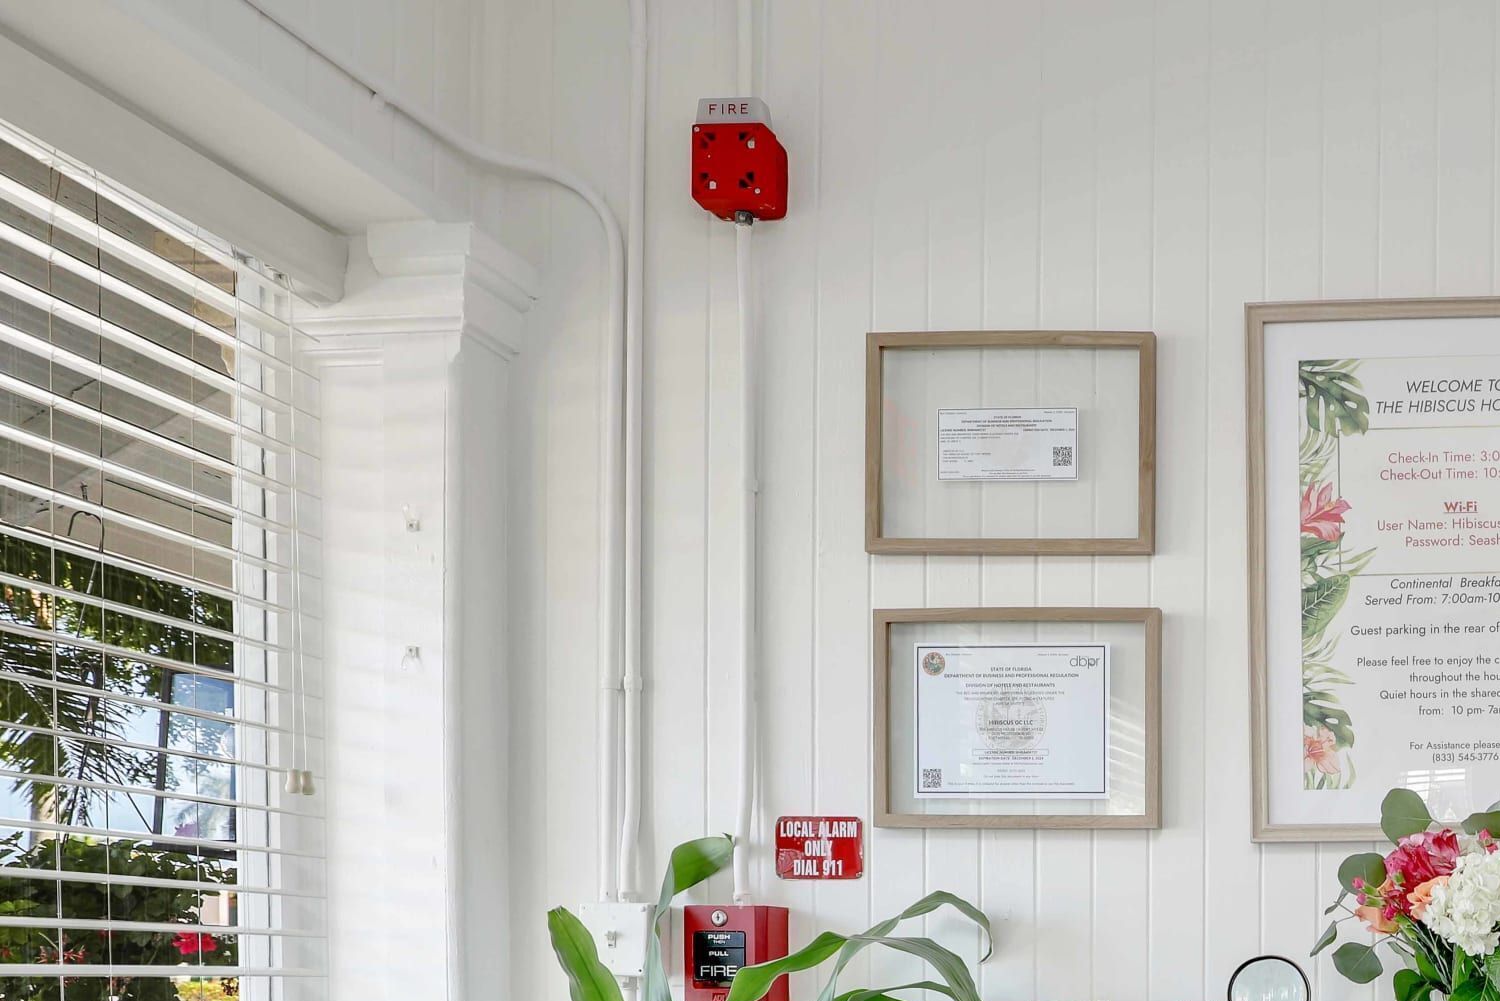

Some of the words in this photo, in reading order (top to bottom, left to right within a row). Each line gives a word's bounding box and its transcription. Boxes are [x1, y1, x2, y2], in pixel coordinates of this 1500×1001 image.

[708, 103, 749, 115] FIRE
[1406, 379, 1483, 394] WELCOME
[1376, 400, 1404, 414] THE
[1408, 398, 1475, 414] HIBISCUS
[1388, 450, 1439, 464] Check-In
[1443, 451, 1475, 463] Time:
[1380, 467, 1442, 481] Check-Out
[1446, 467, 1478, 480] Time:
[1444, 501, 1478, 514] Wi-Fi
[1378, 519, 1404, 531] User
[1408, 519, 1447, 531] Name:
[1406, 533, 1464, 547] Password:
[1390, 576, 1453, 590] Continental
[1365, 593, 1403, 606] Served
[1406, 594, 1437, 605] From:
[1350, 625, 1382, 636] Guest
[1386, 623, 1426, 638] parking
[1430, 624, 1440, 634] in
[1444, 622, 1461, 634] the
[1464, 625, 1485, 634] rear
[1489, 621, 1500, 633] of
[1357, 656, 1388, 667] Please
[1391, 655, 1409, 666] feel
[1412, 655, 1431, 666] free
[1434, 657, 1444, 665] to
[1446, 656, 1473, 668] enjoy
[1476, 654, 1491, 665] the
[1410, 671, 1462, 685] throughout
[1465, 671, 1481, 681] the
[1380, 690, 1407, 700] Quiet
[1410, 688, 1437, 699] hours
[1440, 689, 1449, 698] in
[1452, 688, 1467, 698] the
[1419, 705, 1444, 716] from:
[1452, 705, 1464, 715] 10
[1410, 741, 1423, 750] For
[1426, 741, 1471, 750] Assistance
[1473, 740, 1500, 751] please
[1432, 752, 1455, 764] (833)
[1458, 750, 1499, 762] 545-3776
[780, 821, 815, 838] LOCAL
[818, 821, 857, 838] ALARM
[804, 840, 833, 857] ONLY
[793, 860, 819, 876] DIAL
[822, 859, 843, 876] 911
[700, 965, 738, 977] FIRE
